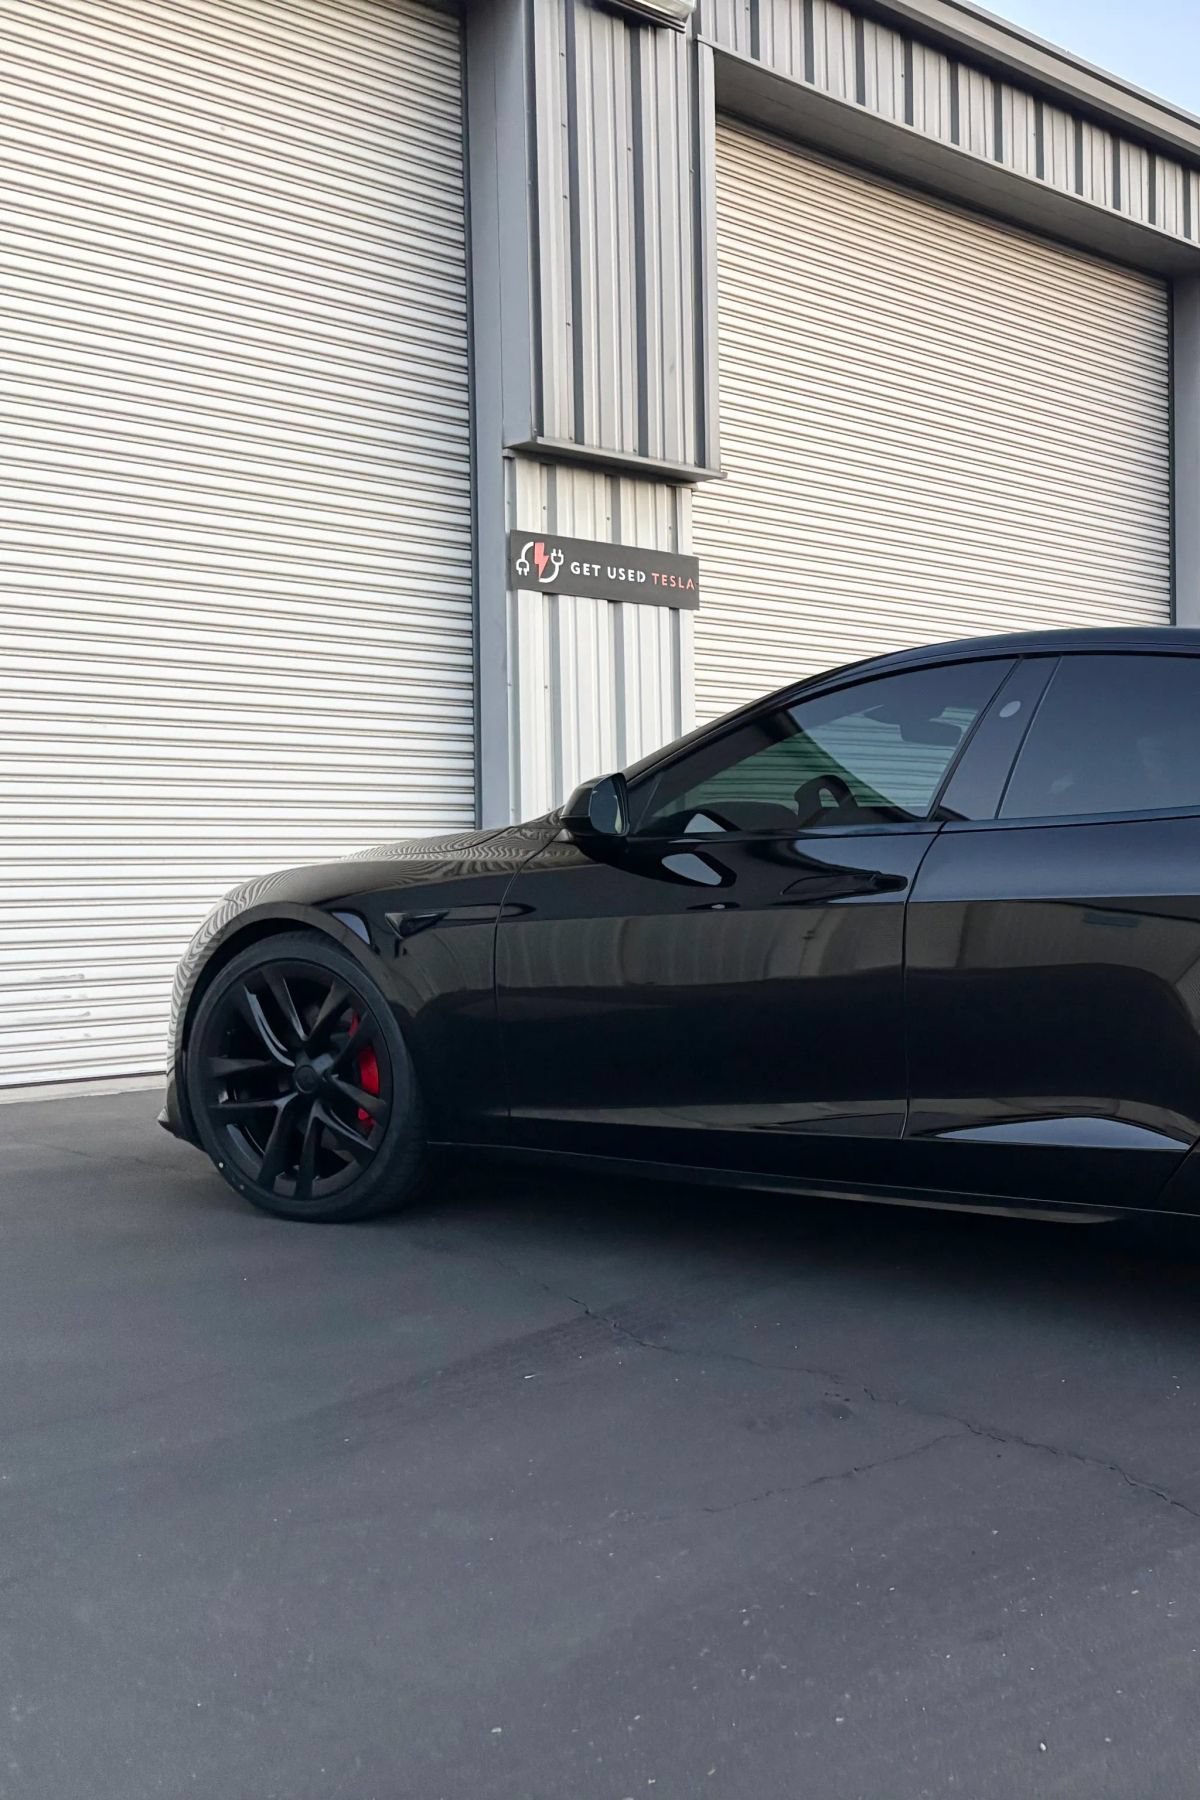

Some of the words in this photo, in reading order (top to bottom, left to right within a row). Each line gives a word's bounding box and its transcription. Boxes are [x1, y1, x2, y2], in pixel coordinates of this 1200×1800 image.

[570, 561, 601, 577] GET
[607, 566, 646, 583] USED
[651, 572, 695, 590] TESLA
